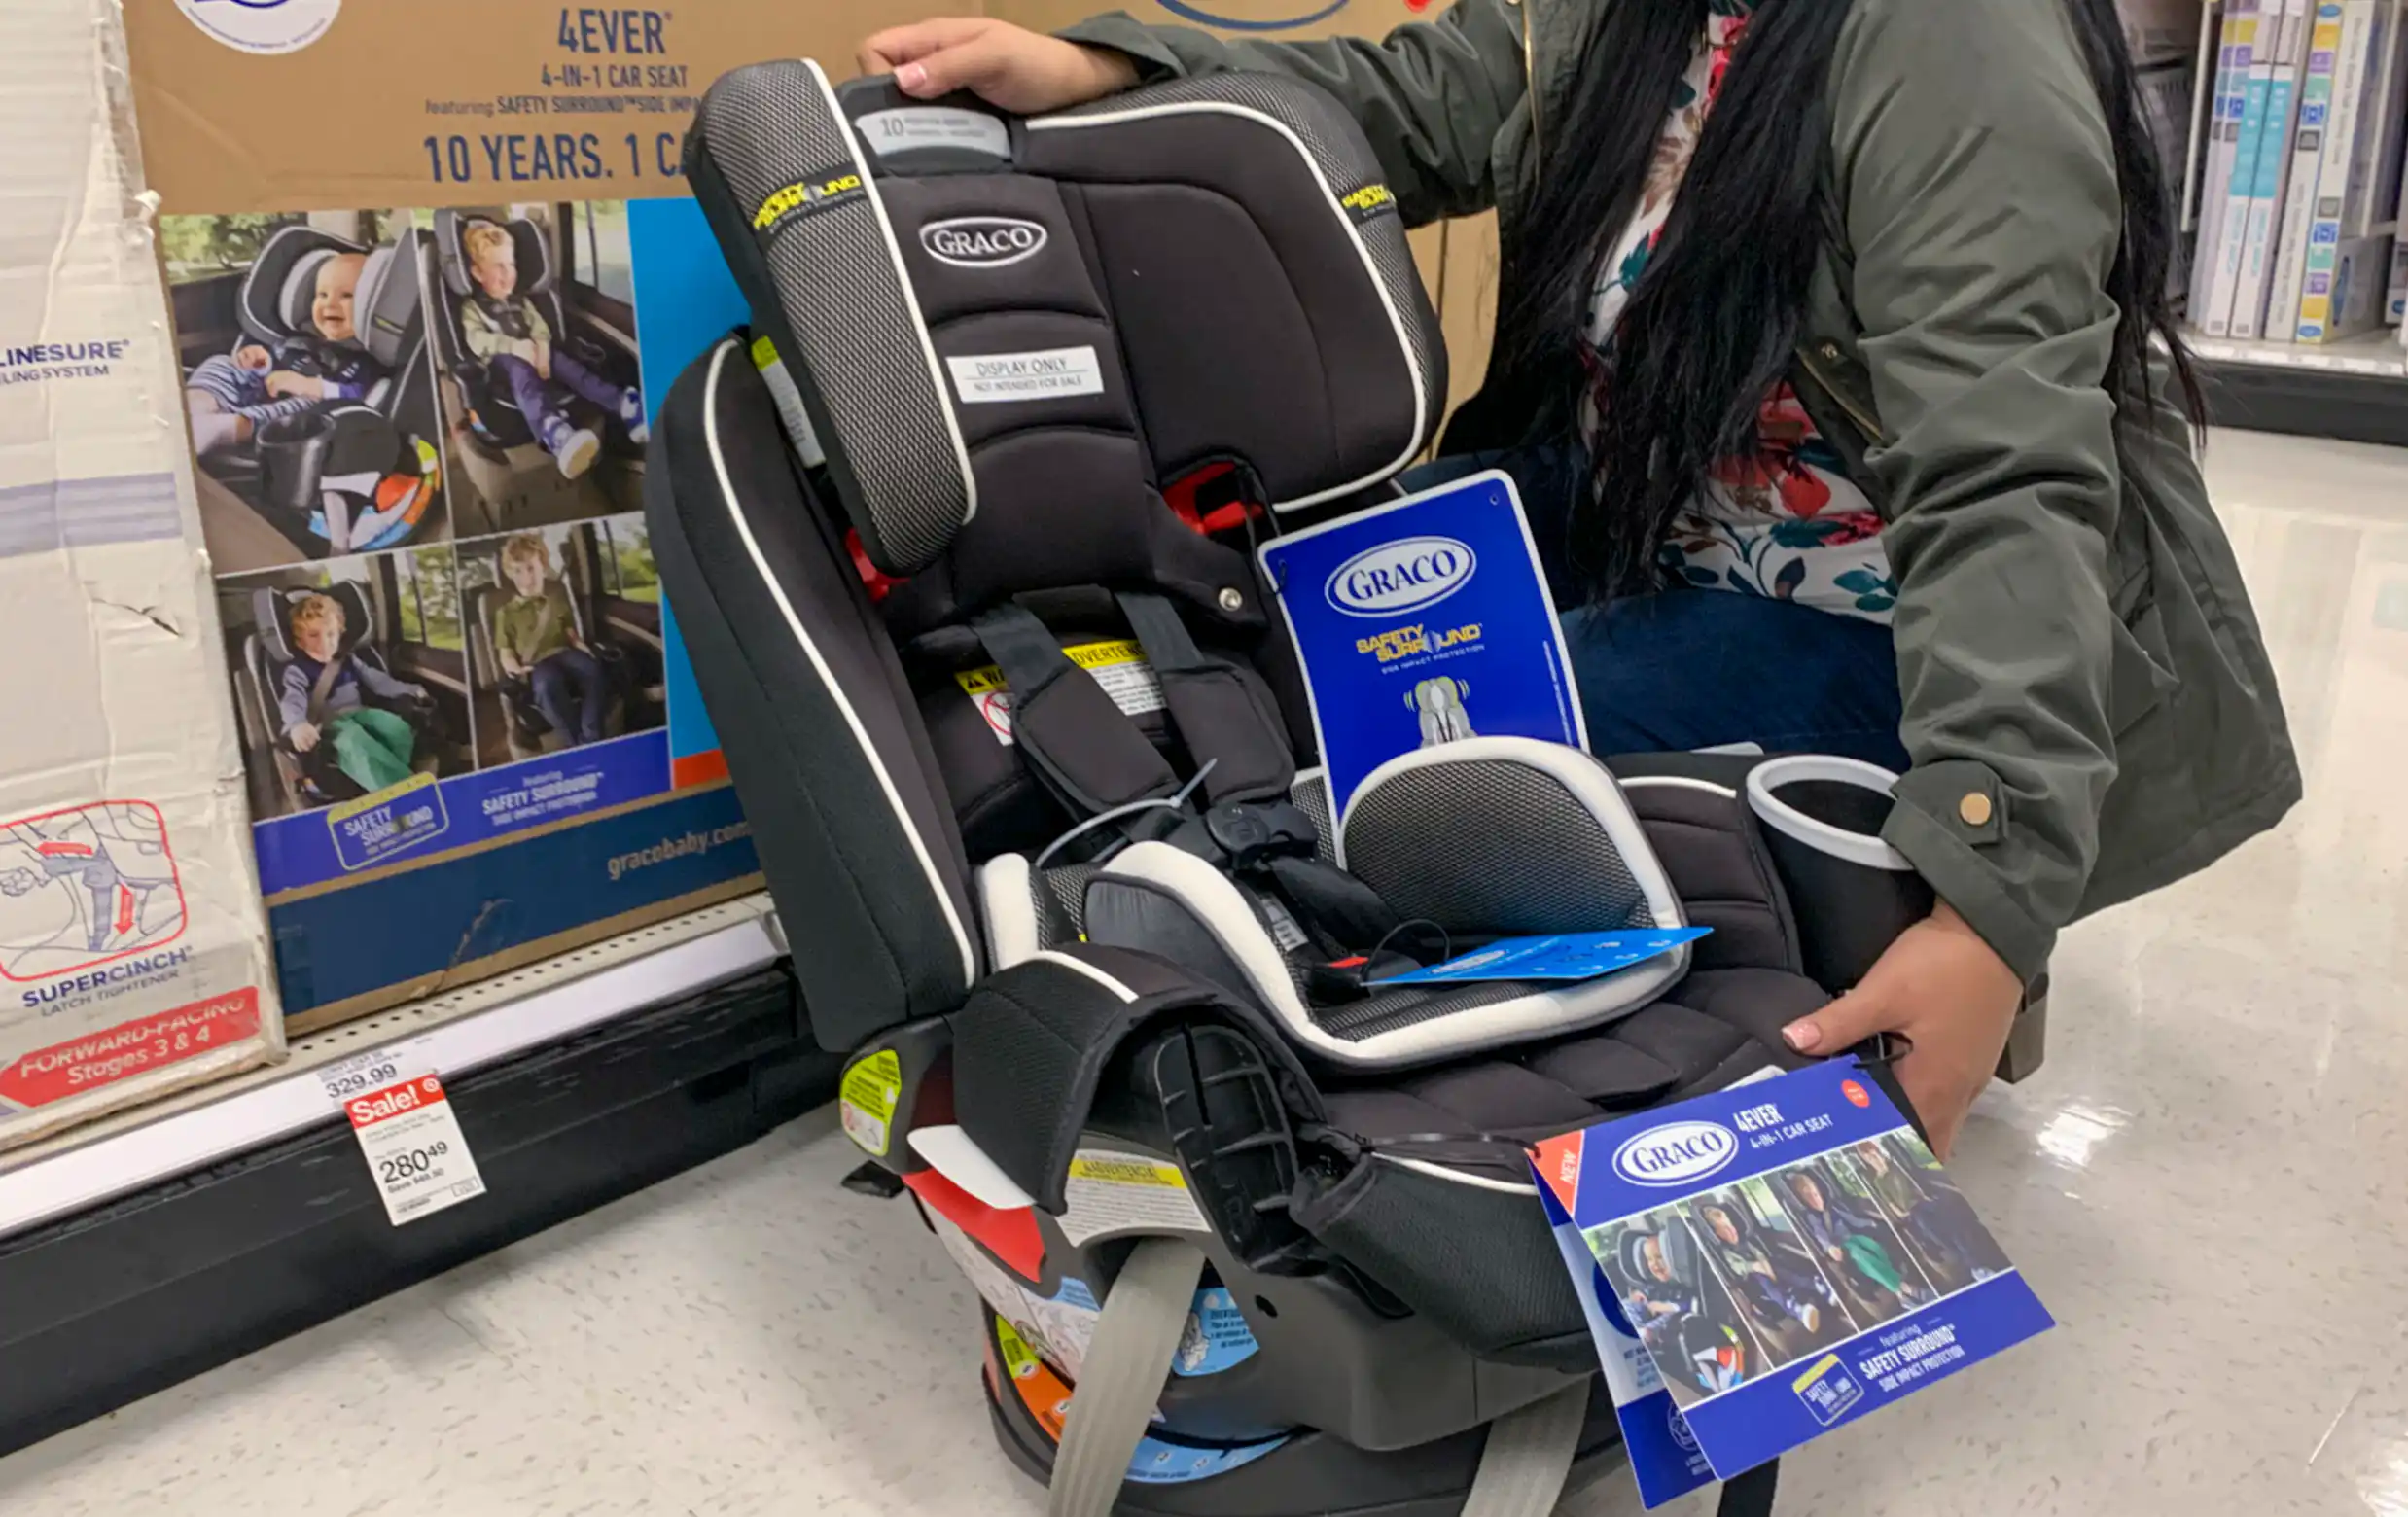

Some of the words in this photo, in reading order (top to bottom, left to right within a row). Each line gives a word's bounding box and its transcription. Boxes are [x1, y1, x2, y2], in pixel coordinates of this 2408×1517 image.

[558, 9, 666, 53] 4EVER
[541, 64, 602, 88] 4-IN-1
[608, 65, 643, 88] CAR
[646, 65, 688, 88] SEAT
[425, 99, 495, 118] featuring
[496, 95, 549, 114] SAFETY
[879, 117, 905, 137] 10
[424, 134, 471, 183] 10
[480, 132, 613, 182] YEARS.
[625, 132, 641, 178] 1
[655, 131, 687, 178] C
[933, 227, 1034, 256] GRACO
[0, 340, 124, 368] INESURE
[975, 358, 1026, 377] DISPLAY
[1031, 356, 1068, 373] ONLY
[41, 365, 110, 380] SYSTEM
[974, 381, 992, 392] NOT
[995, 379, 1038, 392] INTENDED
[1039, 377, 1058, 388] FOR
[1060, 374, 1082, 386] SALE
[1346, 548, 1458, 602] GRACO
[1071, 642, 1146, 664] DVERTEN
[1356, 623, 1424, 654] SAFETY
[1433, 644, 1485, 661] PROTECTION
[482, 789, 529, 816] SAFETY
[344, 805, 391, 837] SAFETY
[22, 947, 188, 1008] SUPERCINCH
[41, 992, 92, 1017] LATCH
[96, 970, 180, 1000] TIGHTENER
[20, 996, 246, 1079] FORWARD-FACING
[66, 1049, 149, 1086] Stages
[155, 1037, 169, 1058] 3
[174, 1033, 191, 1053] &
[195, 1024, 211, 1043] 4
[326, 1062, 398, 1099] 329.99
[351, 1083, 421, 1123] Sale!
[1733, 1103, 1784, 1134] 4EVER
[1749, 1129, 1784, 1149] 4-IN-1
[1785, 1121, 1807, 1141] CAR
[1805, 1113, 1835, 1134] SEAT
[1559, 1148, 1577, 1185] NEW
[1631, 1129, 1725, 1175] GRACO
[1859, 1348, 1903, 1381] SAFETY
[1897, 1324, 1956, 1362] SURROUND
[1921, 1343, 1966, 1373] PROTECTION
